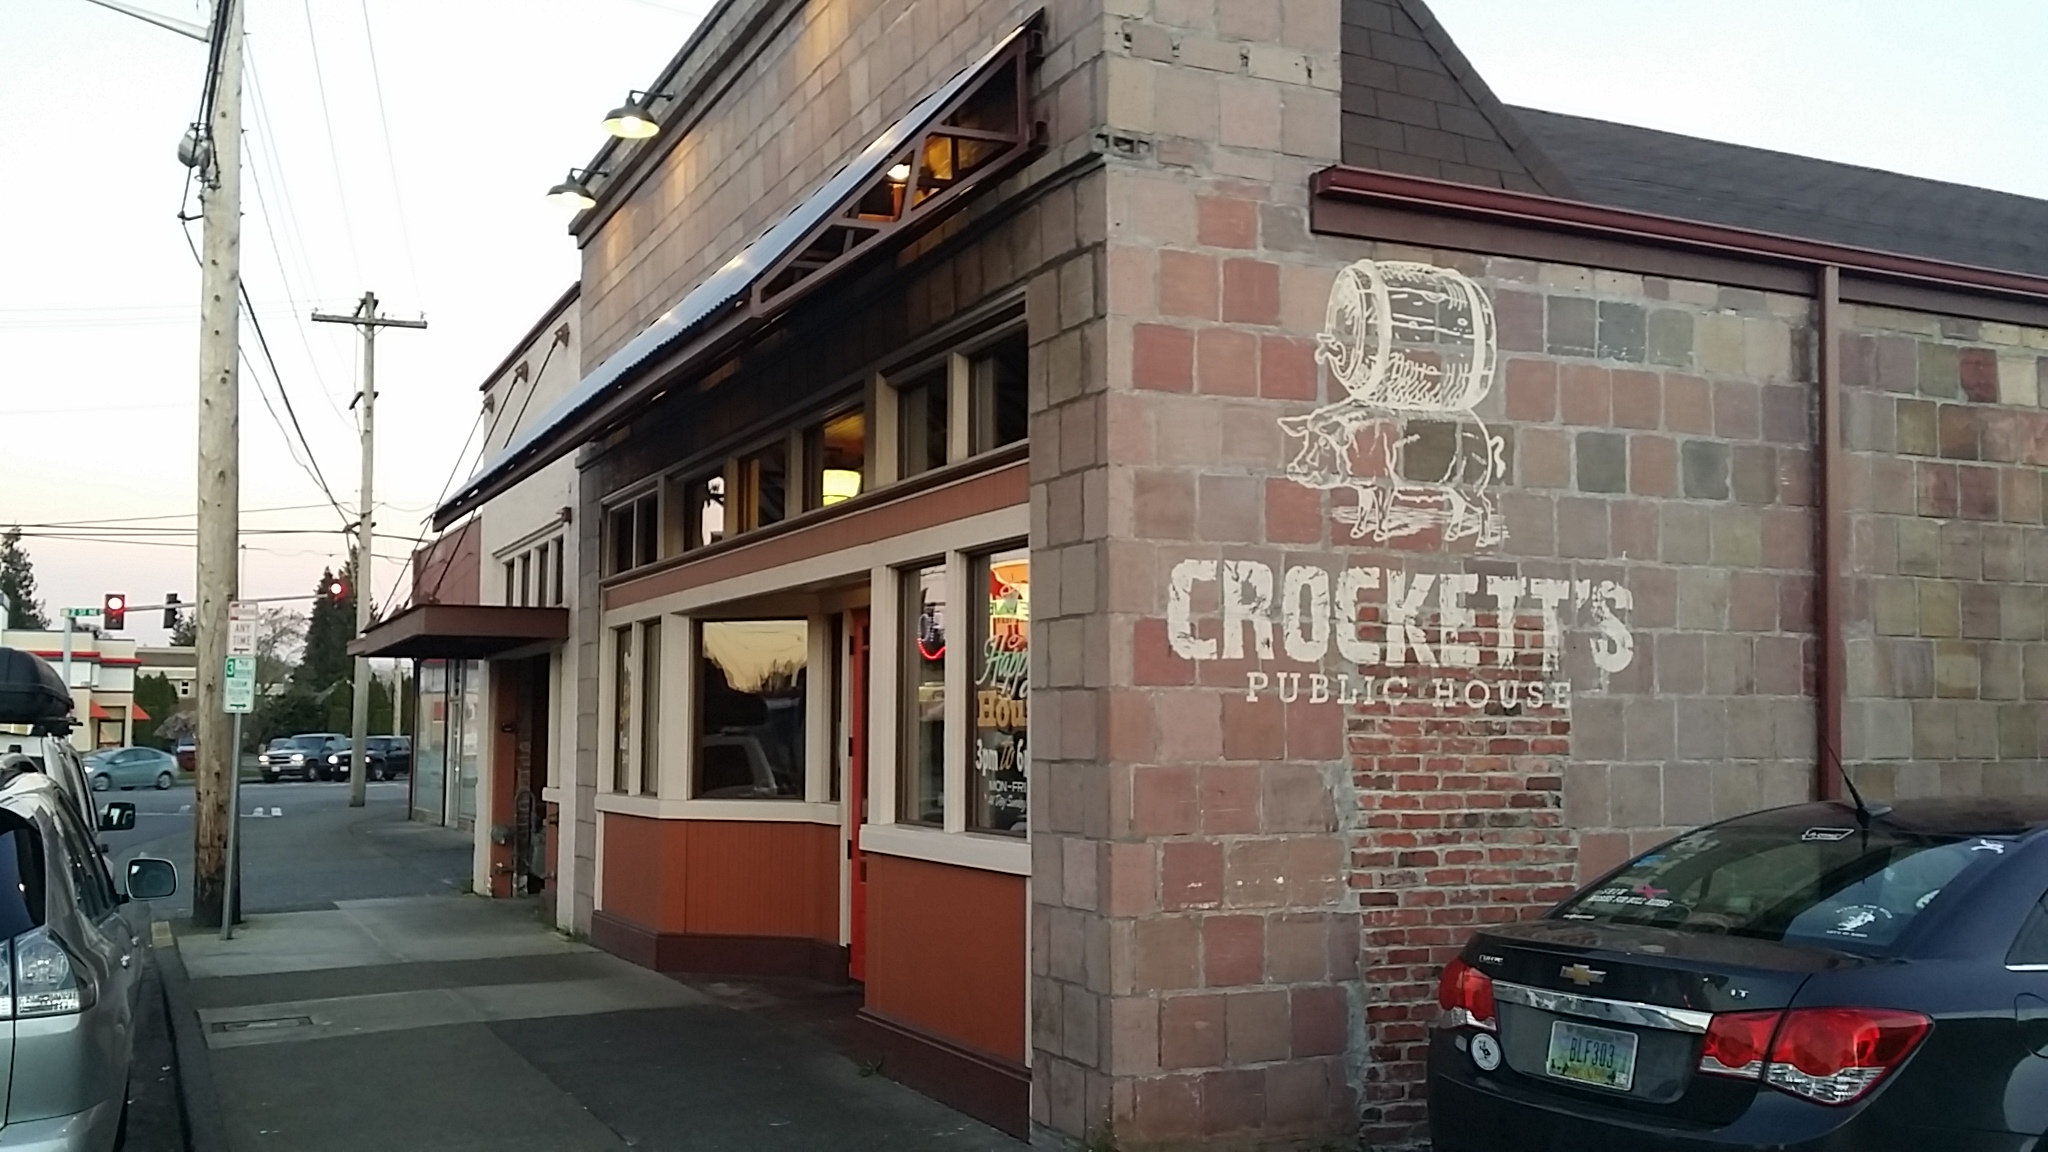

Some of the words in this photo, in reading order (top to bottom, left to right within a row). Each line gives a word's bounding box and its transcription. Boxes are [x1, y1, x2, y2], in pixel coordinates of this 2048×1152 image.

[1167, 558, 1635, 673] CROCKETT'S
[975, 634, 1029, 699] Happ
[977, 689, 1028, 728] Hou
[1246, 672, 1409, 706] PUBLIC
[1431, 676, 1573, 710] HOUSE
[975, 738, 999, 777] 3pm
[1569, 1037, 1616, 1069] BLF303
